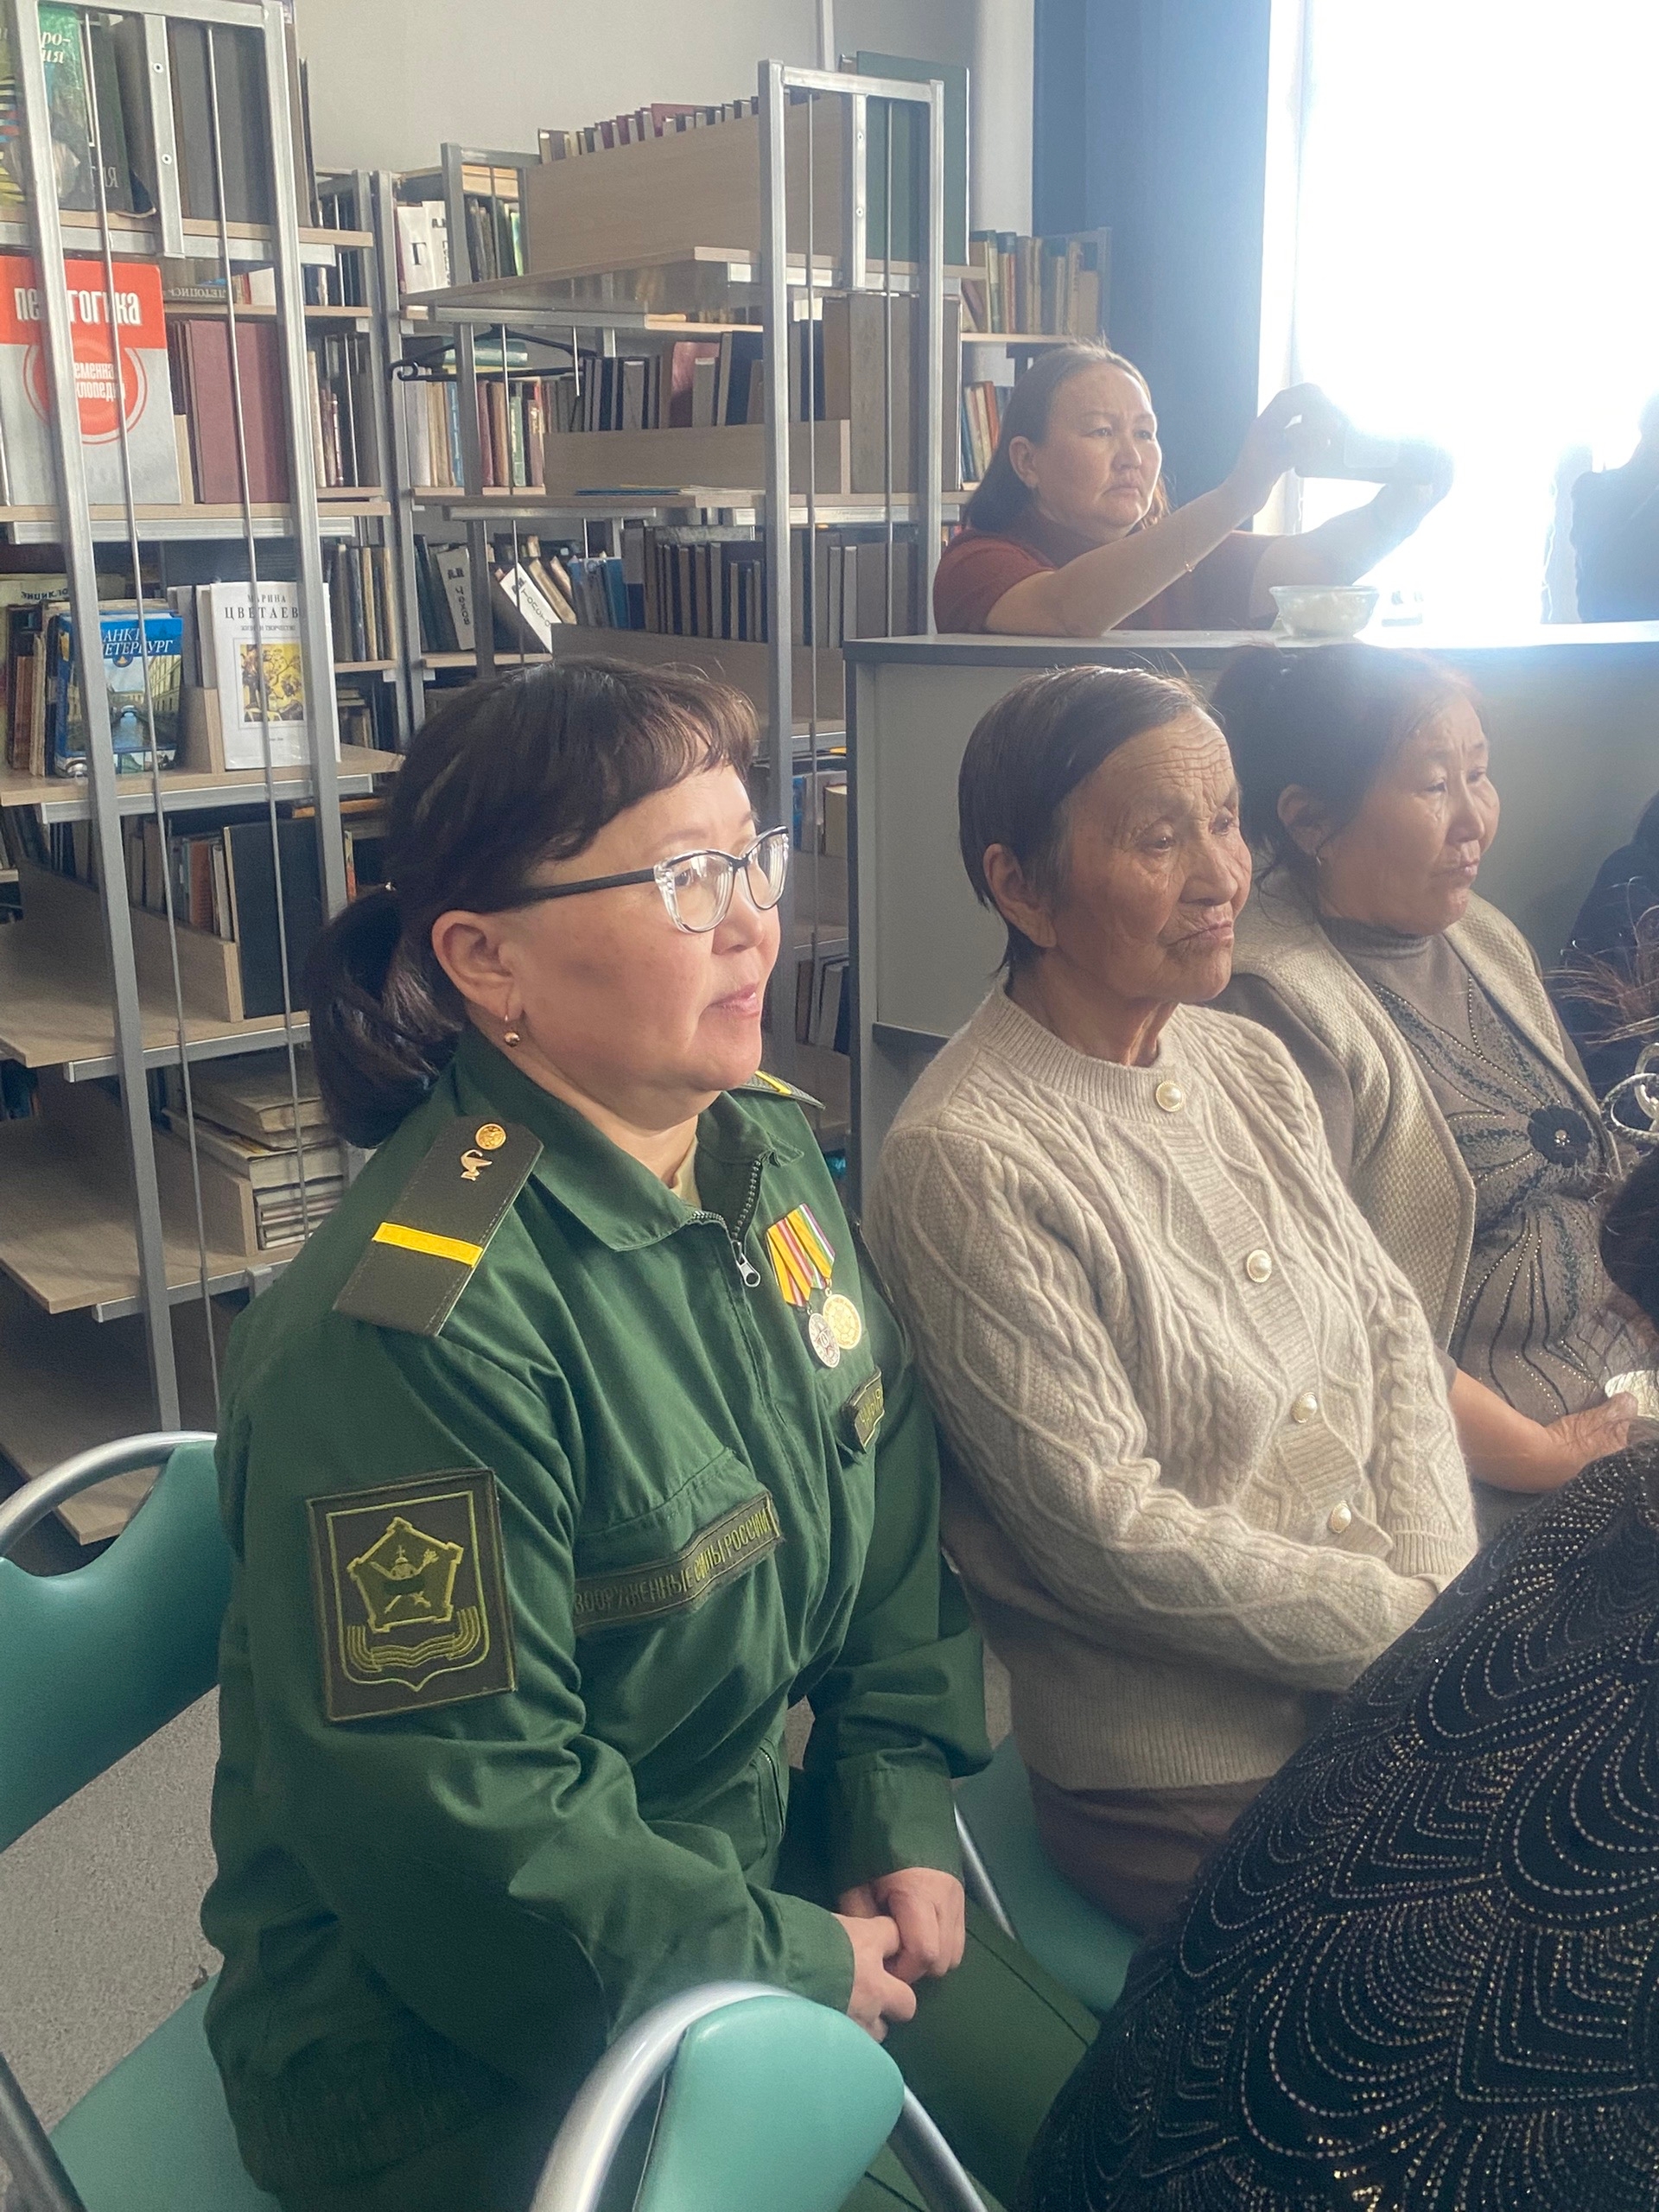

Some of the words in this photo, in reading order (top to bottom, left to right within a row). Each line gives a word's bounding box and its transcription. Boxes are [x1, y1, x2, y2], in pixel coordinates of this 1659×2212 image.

[14, 287, 143, 325] пегогка
[247, 594, 286, 603] МРИНА
[224, 607, 300, 620] ЦВЕТАЕВ
[520, 588, 551, 627] Толсто
[103, 628, 141, 642] АНКТ
[104, 640, 174, 656] ЕТЕРУРГ
[694, 1541, 726, 1581] СИЛЫ
[724, 1509, 771, 1557] РОССИИ
